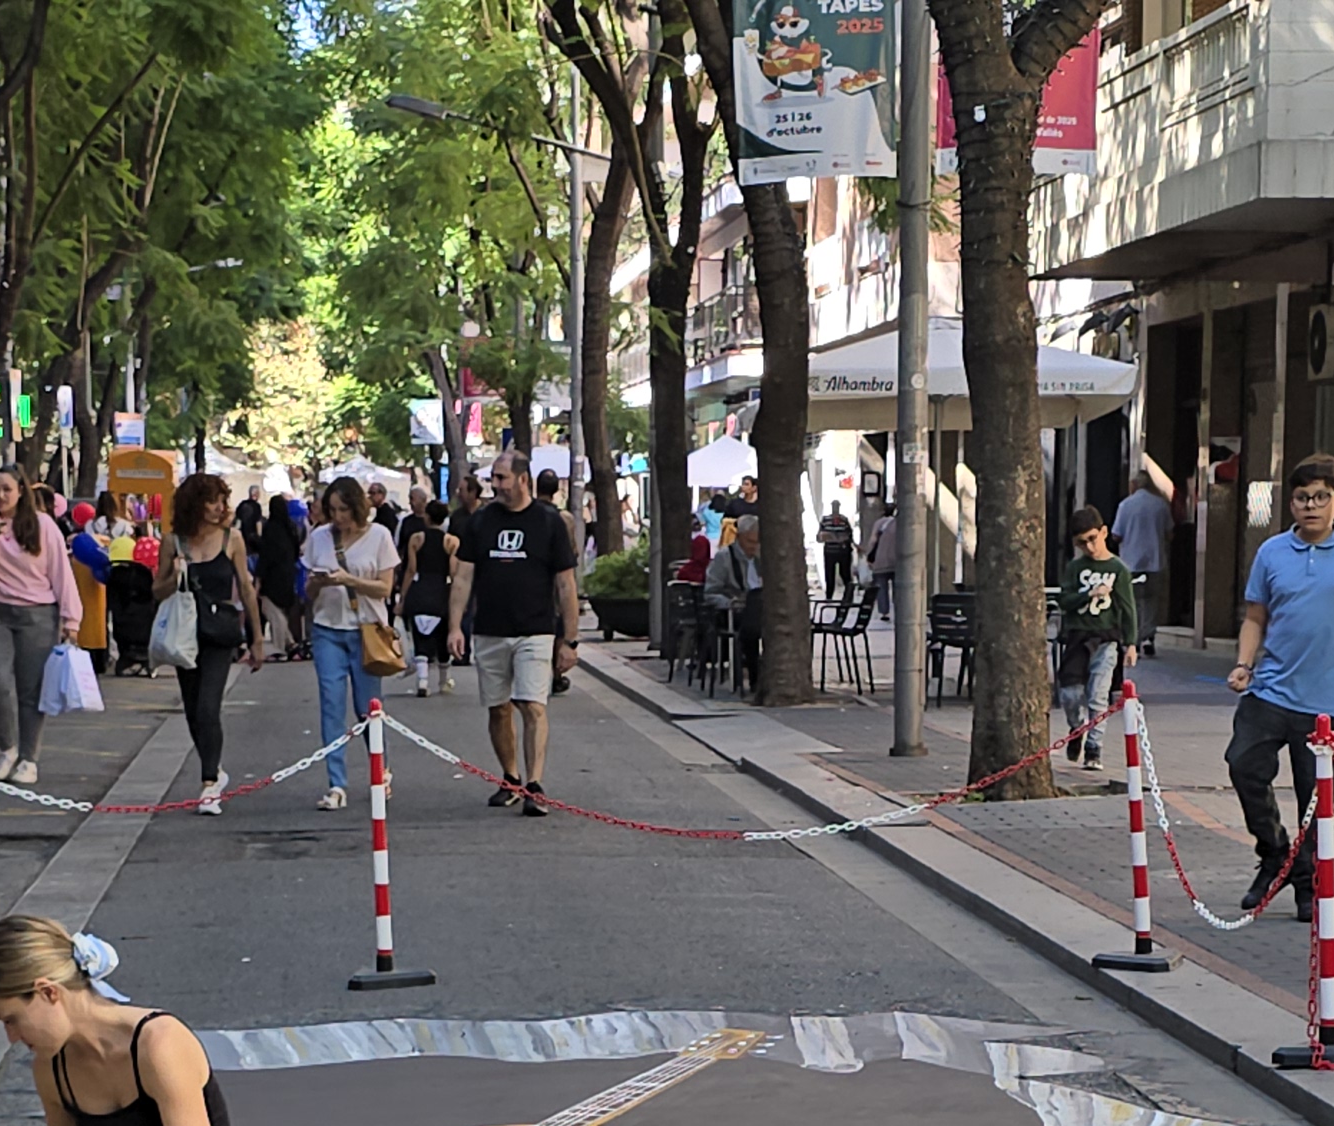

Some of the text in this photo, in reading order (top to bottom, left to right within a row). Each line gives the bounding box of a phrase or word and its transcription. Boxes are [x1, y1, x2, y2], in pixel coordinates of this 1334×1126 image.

[818, 0, 884, 14] TAPES
[836, 17, 884, 35] 2025
[775, 113, 788, 123] 25
[799, 112, 812, 122] 26
[766, 126, 822, 138] d'octubre
[825, 376, 894, 392] Alhambra
